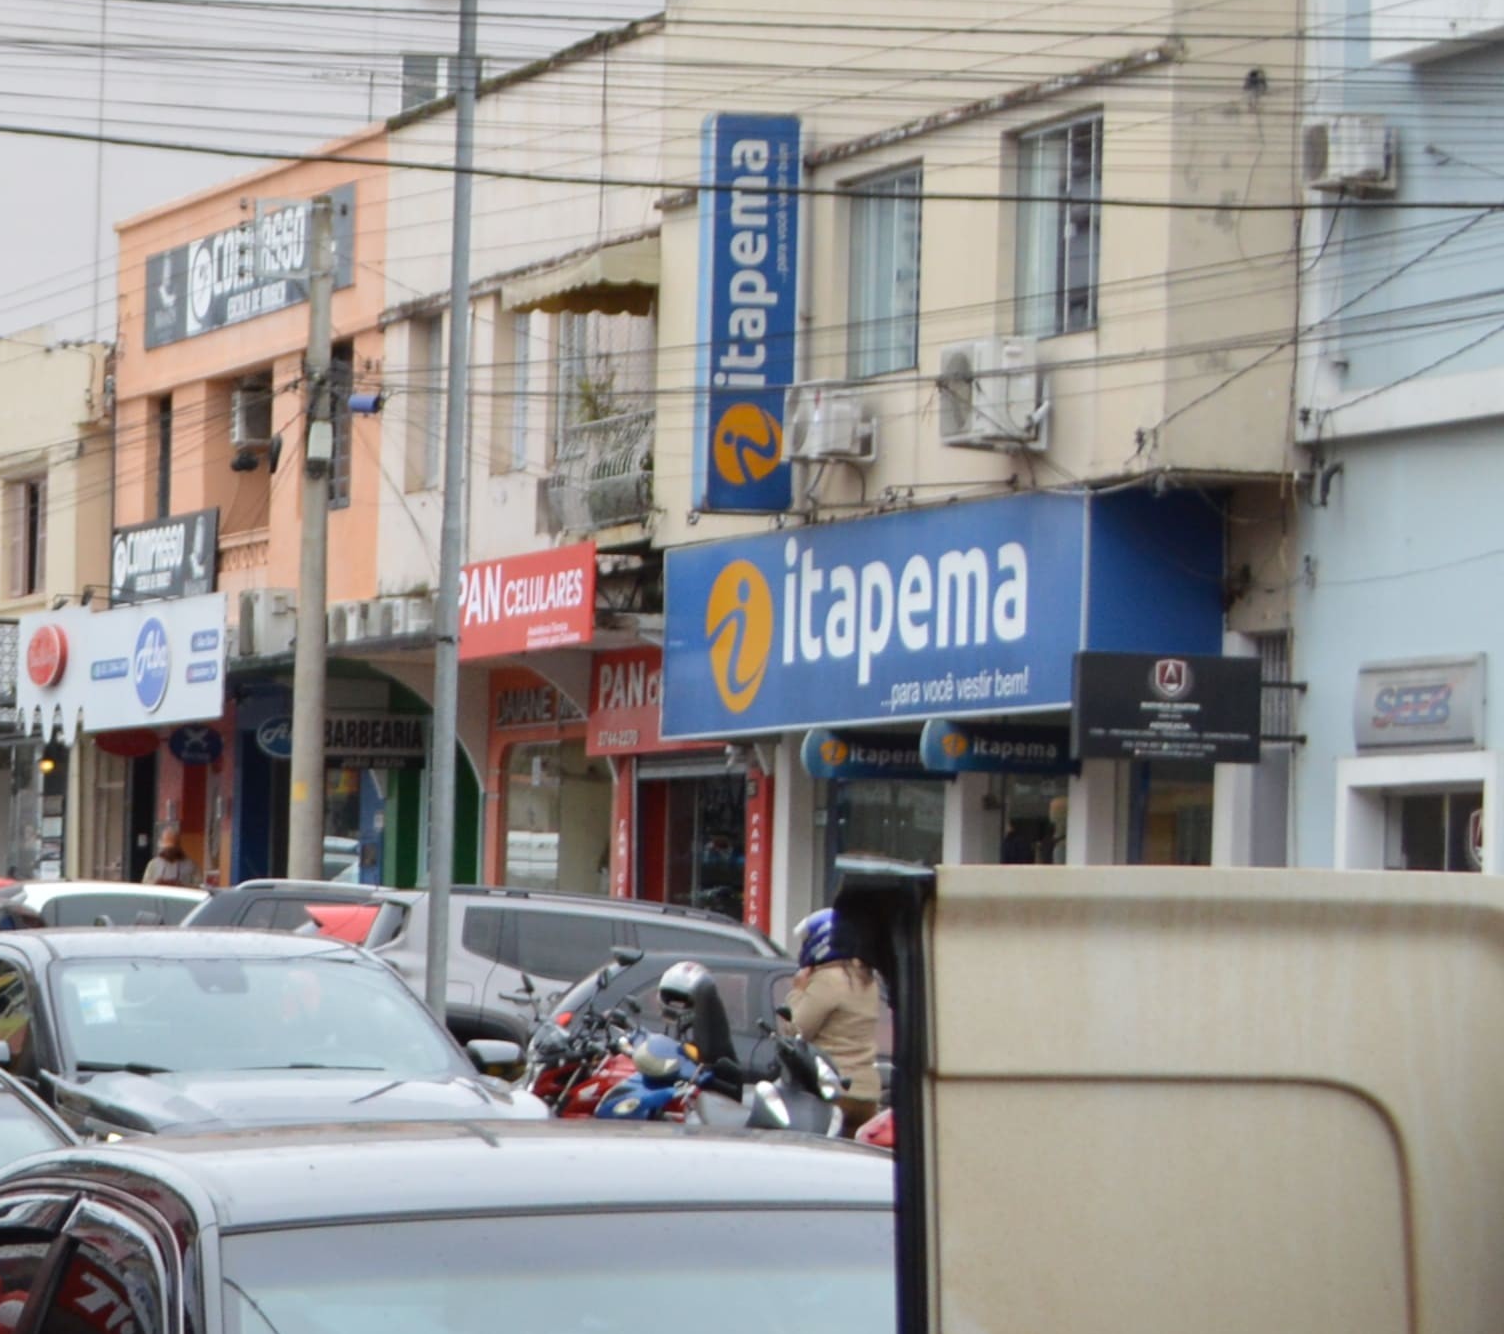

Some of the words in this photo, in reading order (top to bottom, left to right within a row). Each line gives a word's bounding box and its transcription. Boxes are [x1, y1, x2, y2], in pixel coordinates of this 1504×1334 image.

[714, 139, 778, 387] itapema
[503, 568, 583, 617] CELULARES
[782, 536, 1028, 687] itapema
[597, 660, 647, 710] PAN
[922, 674, 954, 703] você
[955, 670, 993, 699] vestir
[994, 666, 1030, 697] bem!
[324, 719, 423, 749] BARBEARIA
[849, 741, 921, 766] itapem
[973, 738, 1057, 760] itapema
